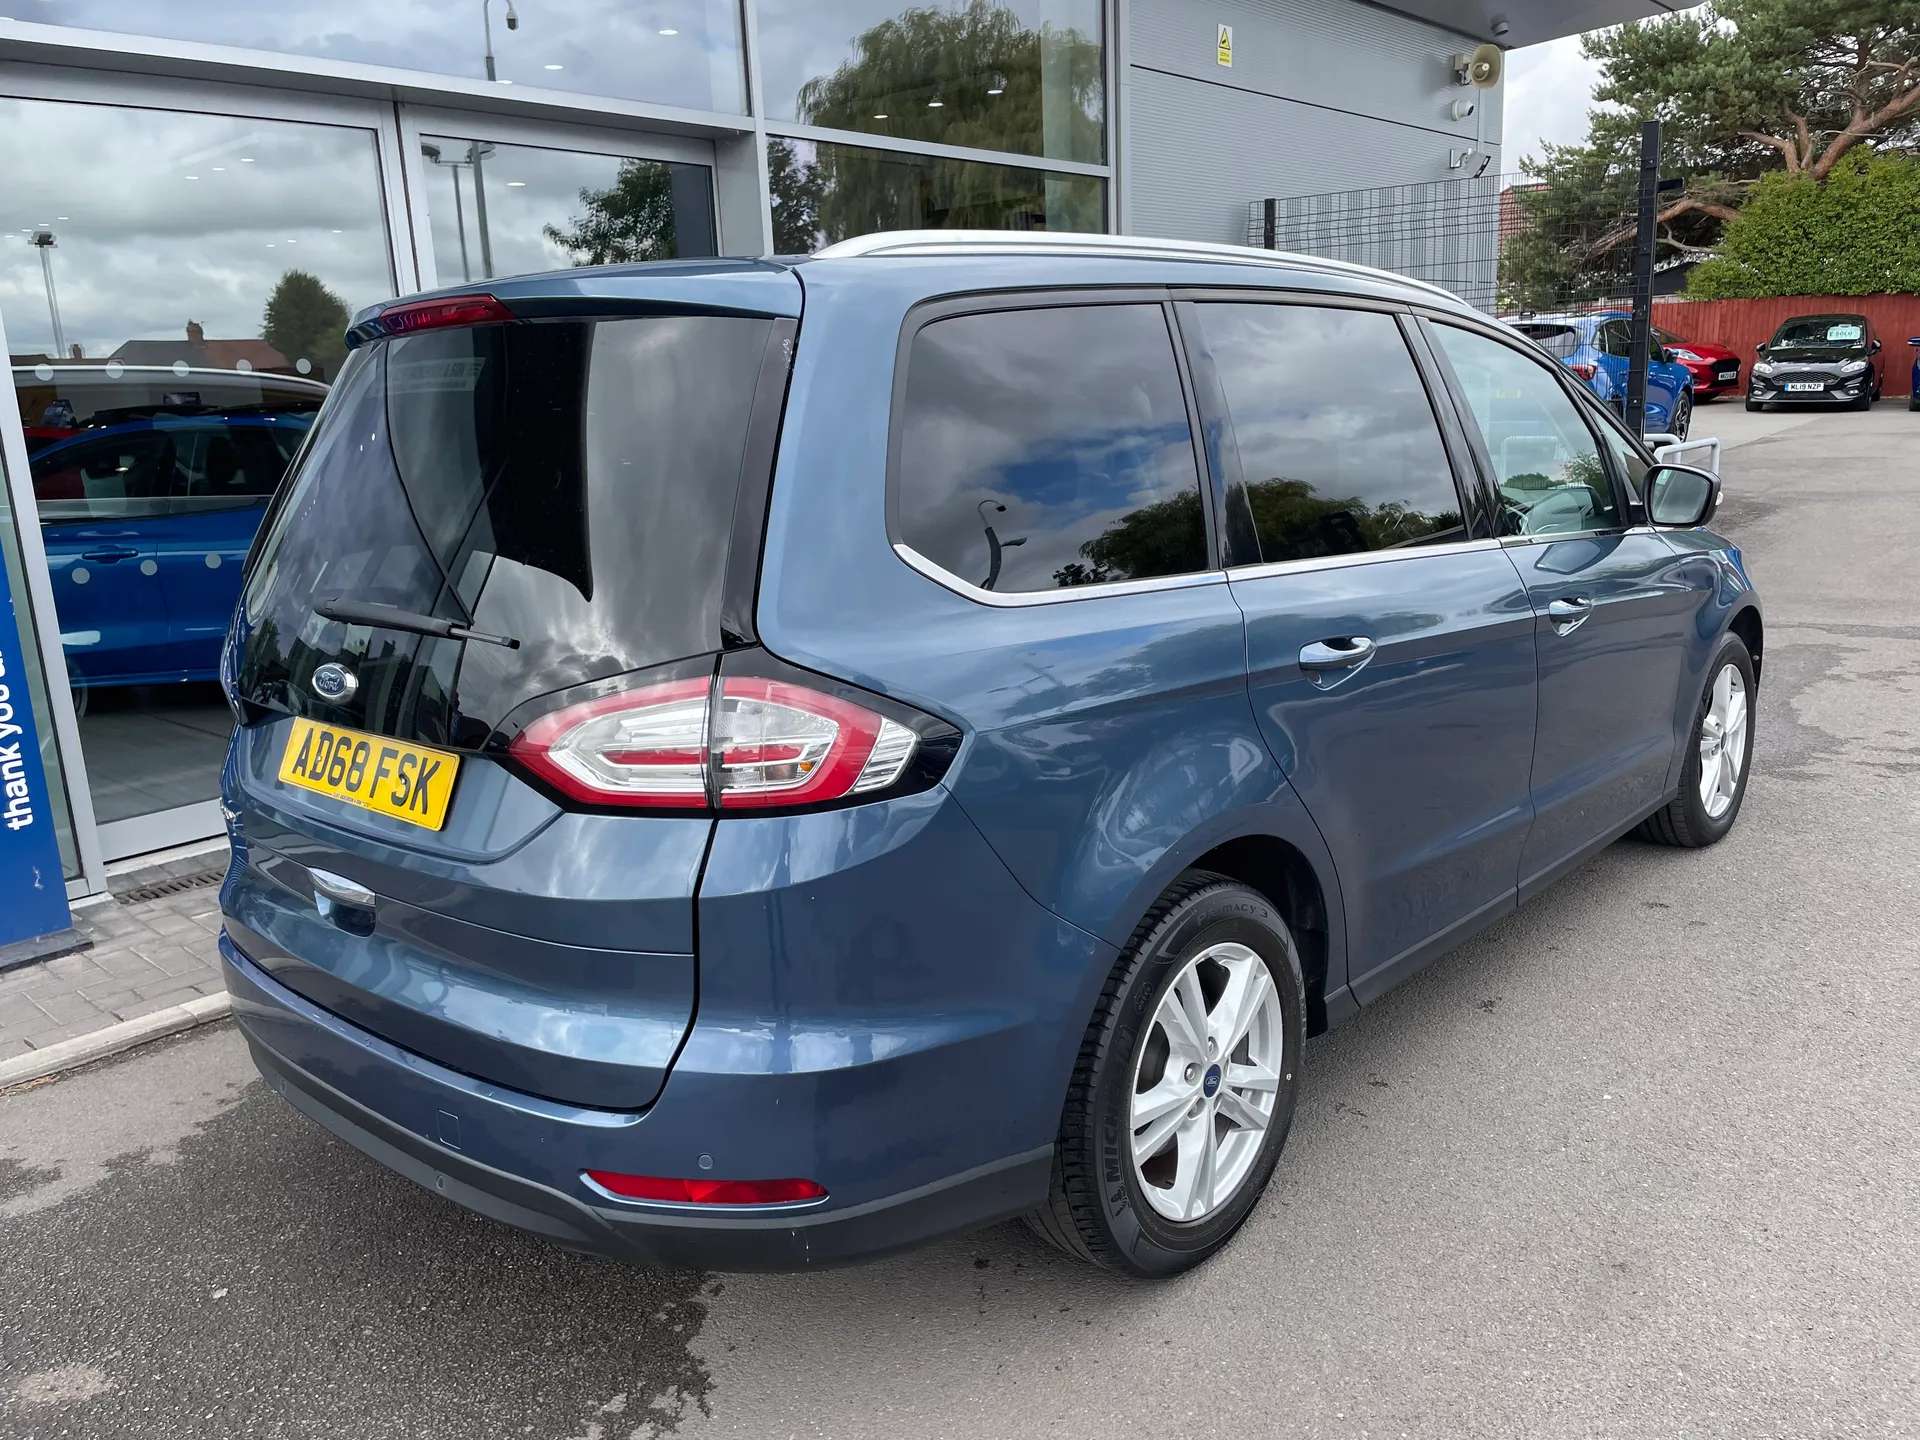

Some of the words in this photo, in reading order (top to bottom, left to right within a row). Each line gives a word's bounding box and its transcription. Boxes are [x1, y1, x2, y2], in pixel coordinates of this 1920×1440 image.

[319, 671, 341, 691] Ford
[0, 742, 34, 830] thank
[292, 727, 370, 792] AD68
[369, 747, 441, 815] FSK
